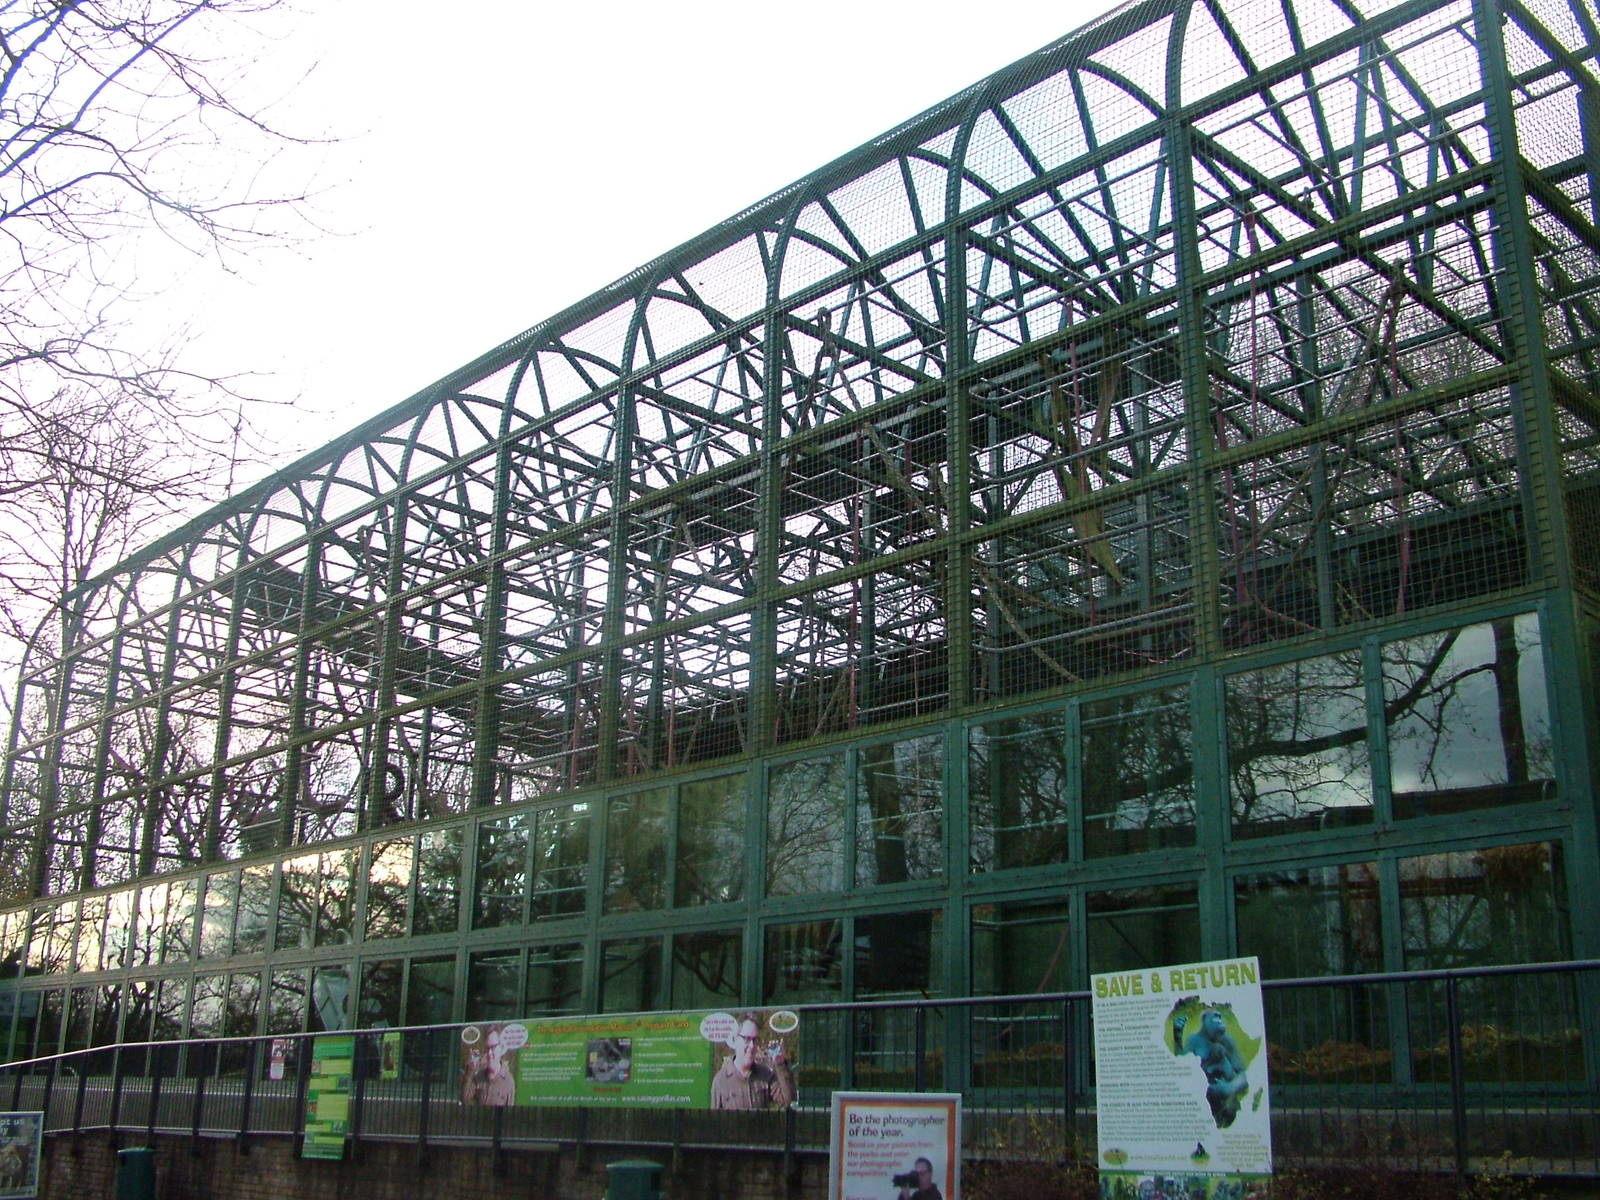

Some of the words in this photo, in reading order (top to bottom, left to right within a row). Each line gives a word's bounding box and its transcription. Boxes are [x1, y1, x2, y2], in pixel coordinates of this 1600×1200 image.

[1096, 974, 1144, 998] SAVE
[1151, 973, 1163, 993] &
[1170, 963, 1257, 992] RETURN
[849, 1113, 862, 1124] Be
[865, 1114, 880, 1124] the
[882, 1114, 944, 1127] photographer
[849, 1127, 860, 1136] of
[862, 1128, 878, 1136] the
[881, 1129, 903, 1139] year.
